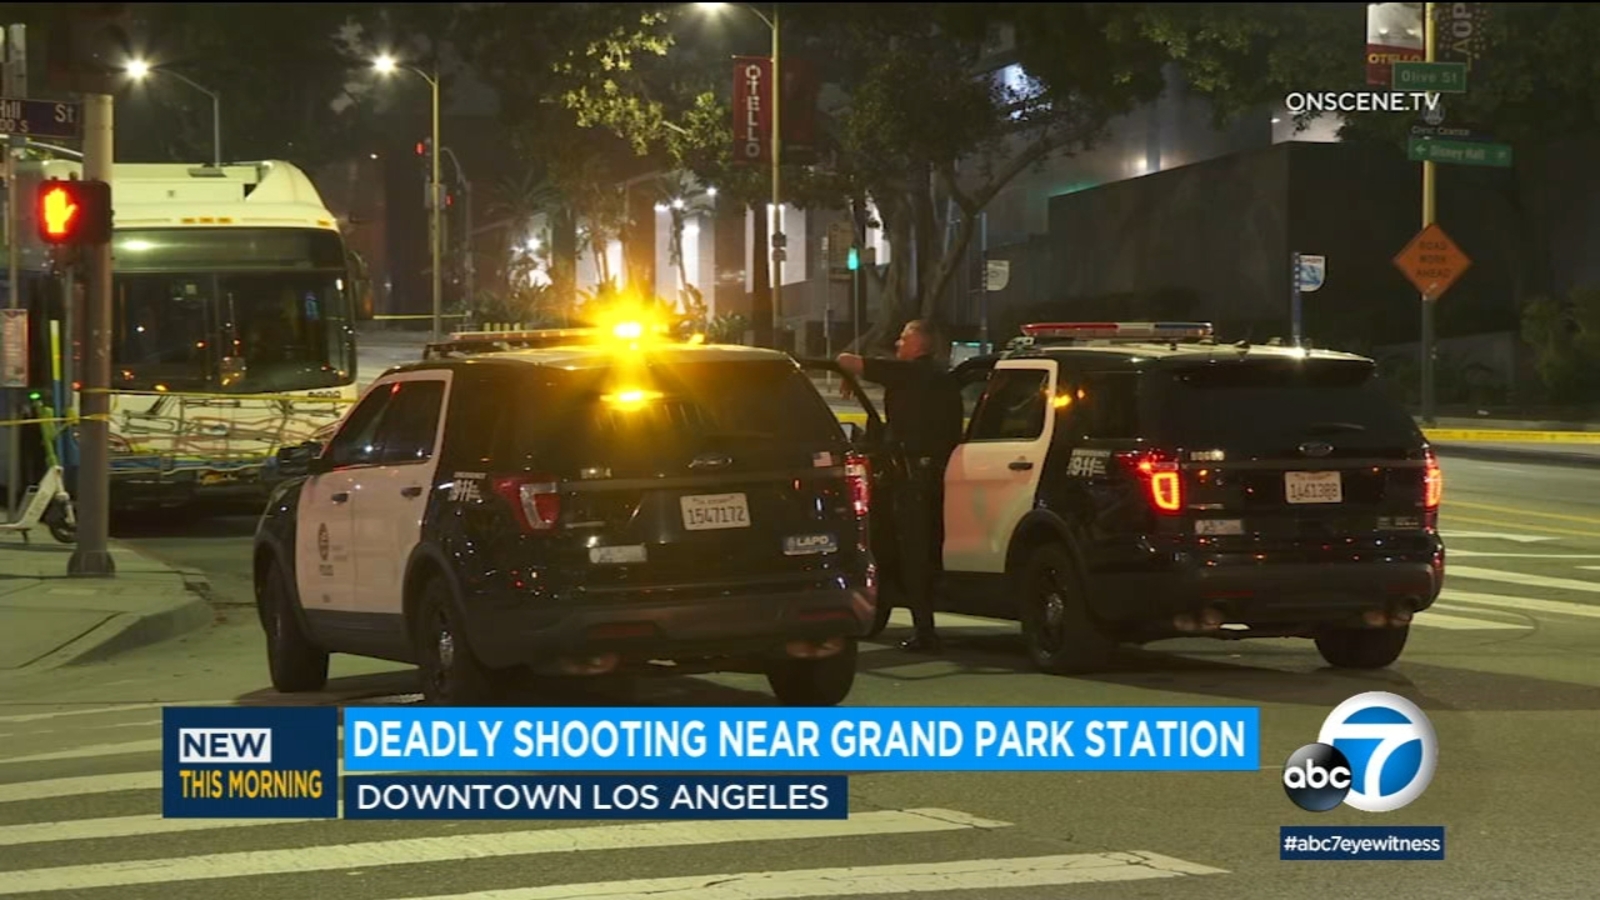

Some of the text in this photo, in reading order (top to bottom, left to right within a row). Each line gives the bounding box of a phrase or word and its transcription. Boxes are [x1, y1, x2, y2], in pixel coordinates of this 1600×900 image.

[1401, 70, 1458, 83] Olive St
[55, 103, 74, 122] St
[745, 64, 761, 158] OTELLO
